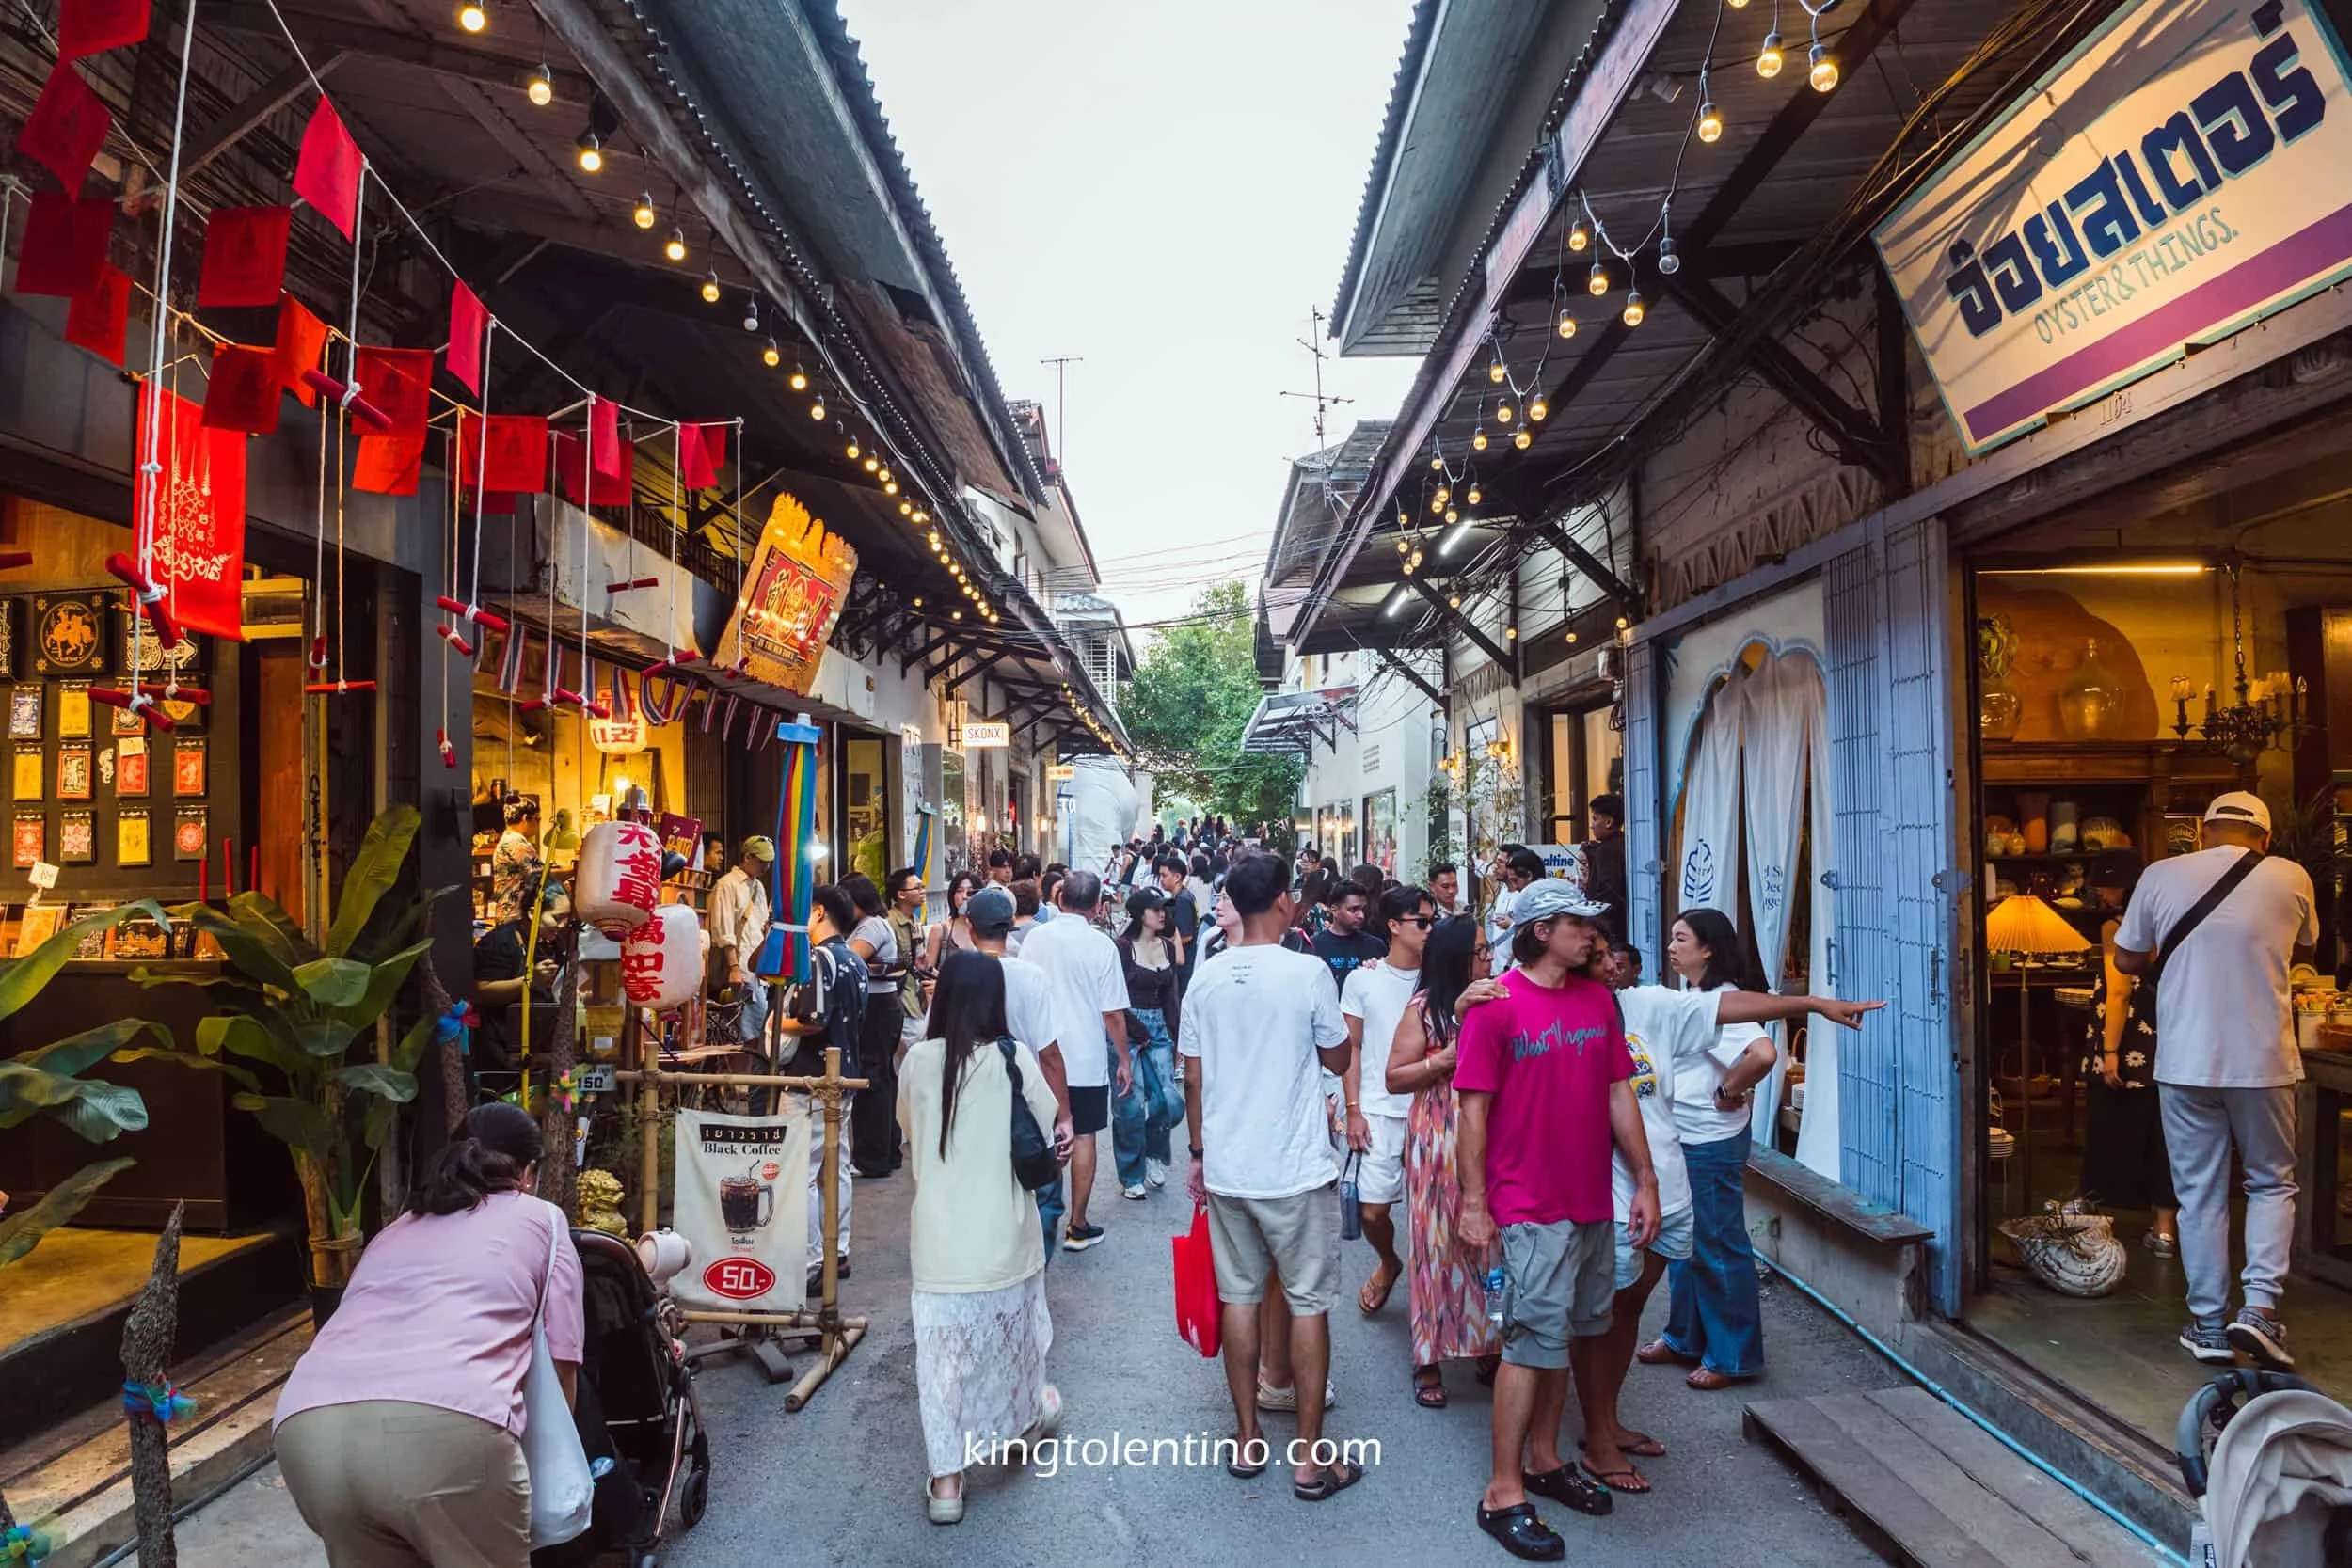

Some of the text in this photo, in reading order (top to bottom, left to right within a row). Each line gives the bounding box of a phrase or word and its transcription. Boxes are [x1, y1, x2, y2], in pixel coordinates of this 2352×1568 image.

[1543, 854, 1574, 866] altine
[1512, 1028, 1552, 1062] West
[705, 1128, 781, 1141] เยาวราช
[704, 1142, 781, 1156] Black Coffee
